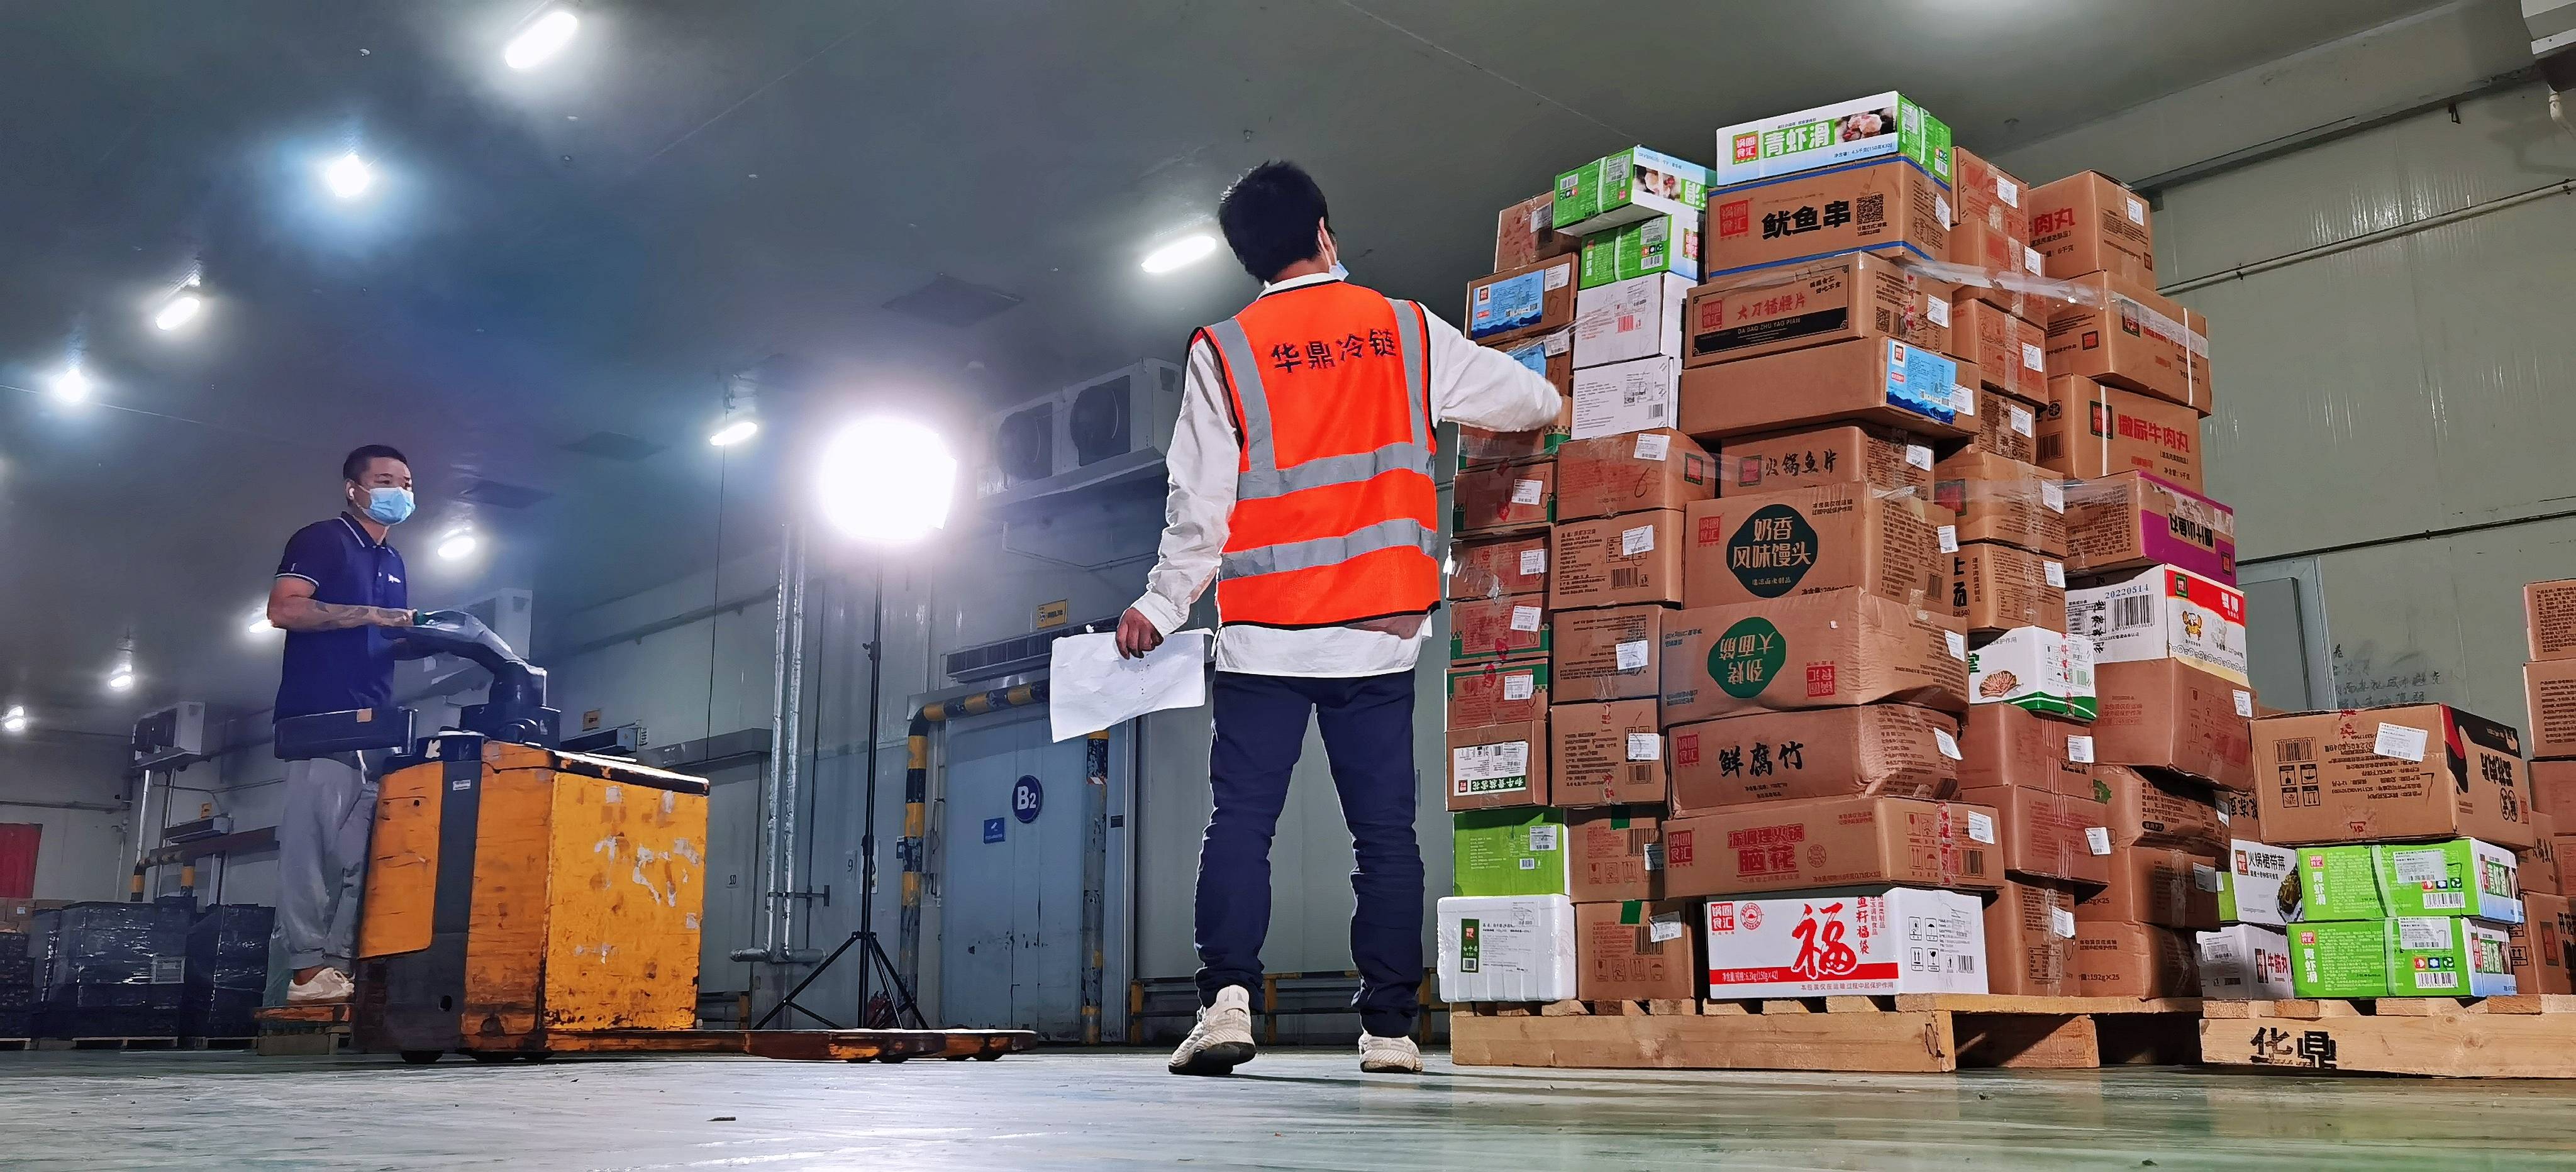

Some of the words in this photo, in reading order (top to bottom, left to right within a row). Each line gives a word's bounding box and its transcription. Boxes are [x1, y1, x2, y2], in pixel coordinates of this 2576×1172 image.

[1765, 122, 1829, 156] 青虾滑
[1762, 201, 1851, 239] 鱿鱼串
[2029, 207, 2075, 236] 肉丸
[1738, 292, 1806, 321] 大刀猪腰片
[1271, 328, 1396, 373] 华鼎冷链
[1765, 448, 1837, 477] 火锅鱼片
[1753, 516, 1794, 542] 奶香
[1732, 541, 1811, 570] 风味馒头
[2105, 583, 2149, 599] 20220514
[1719, 631, 1775, 660] 大面筋
[1728, 659, 1763, 685] 劲烤
[1719, 741, 1804, 778] 鲜腐竹
[1018, 785, 1037, 809] B2
[1738, 845, 1796, 874] 脑花
[2248, 851, 2285, 871] 火锅裙带菜
[1791, 902, 1858, 980] 福
[1801, 981, 1894, 991] 本包装仅在运输过程中起保护作用
[2250, 1027, 2336, 1070] 华鼎
